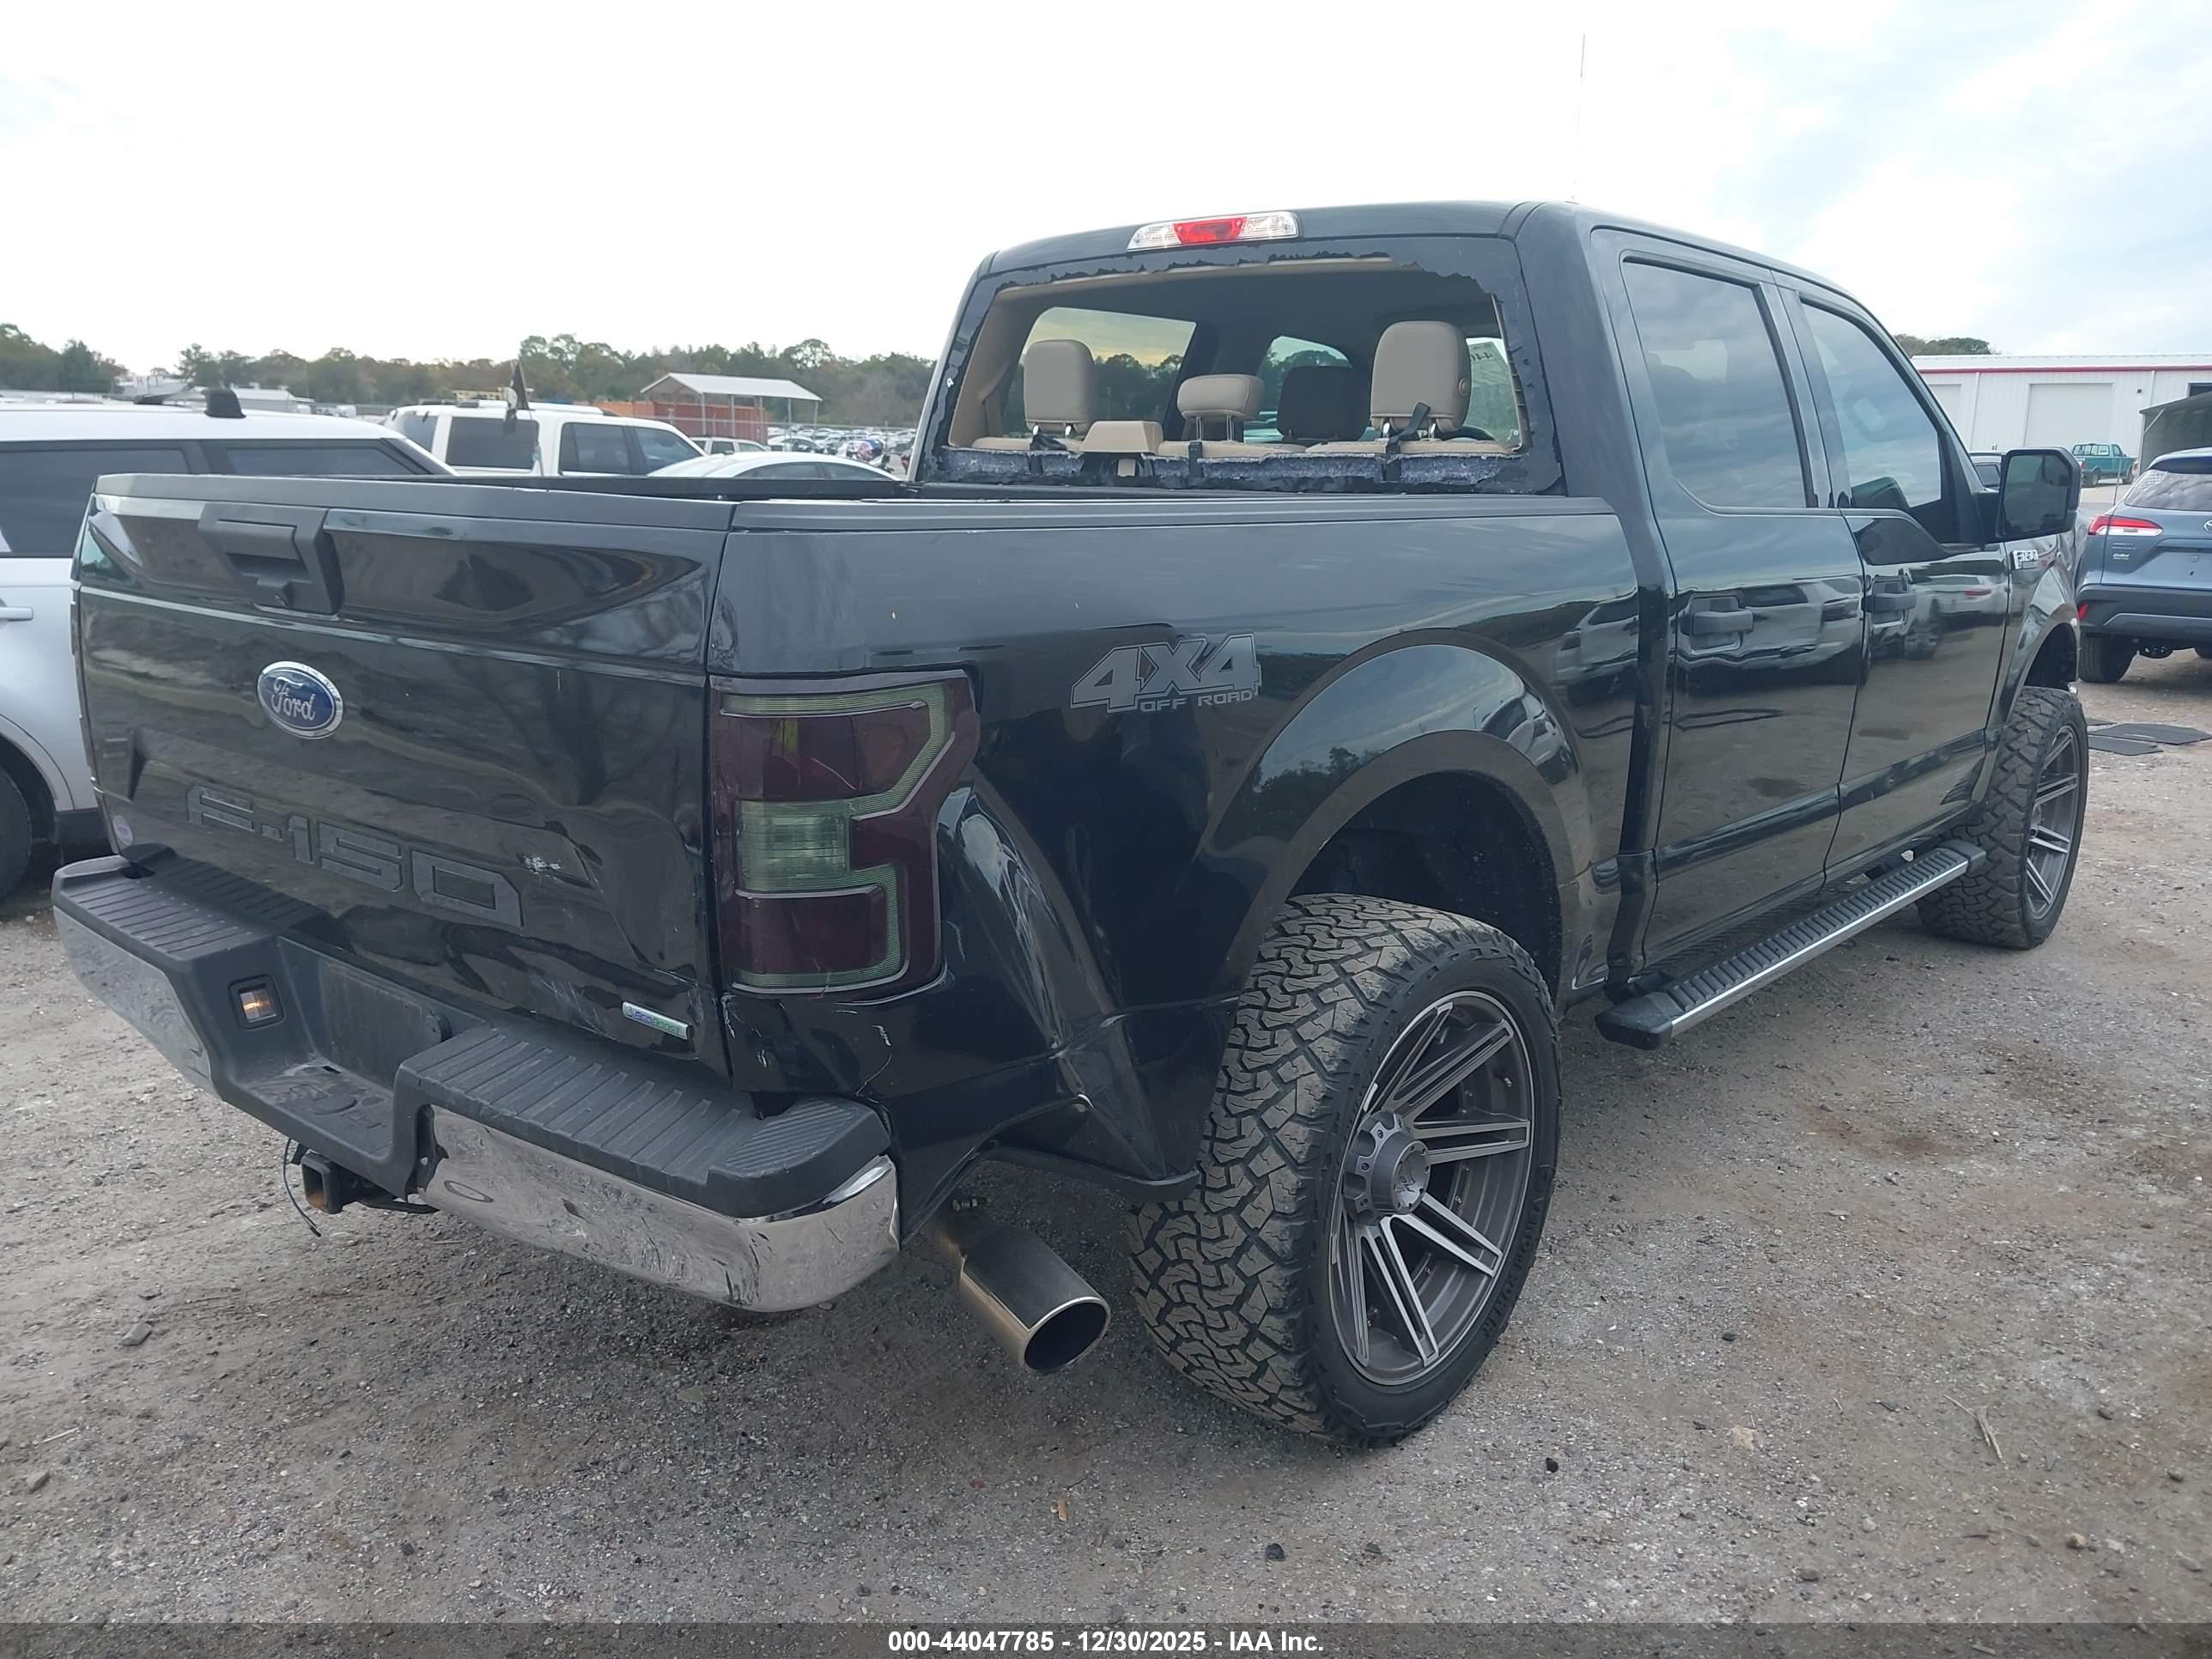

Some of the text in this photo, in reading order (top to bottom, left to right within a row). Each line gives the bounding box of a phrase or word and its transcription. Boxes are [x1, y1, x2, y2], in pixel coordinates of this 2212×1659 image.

[271, 676, 316, 720] Ford
[1139, 690, 1254, 713] OFF ROAD
[185, 783, 525, 928] F-150
